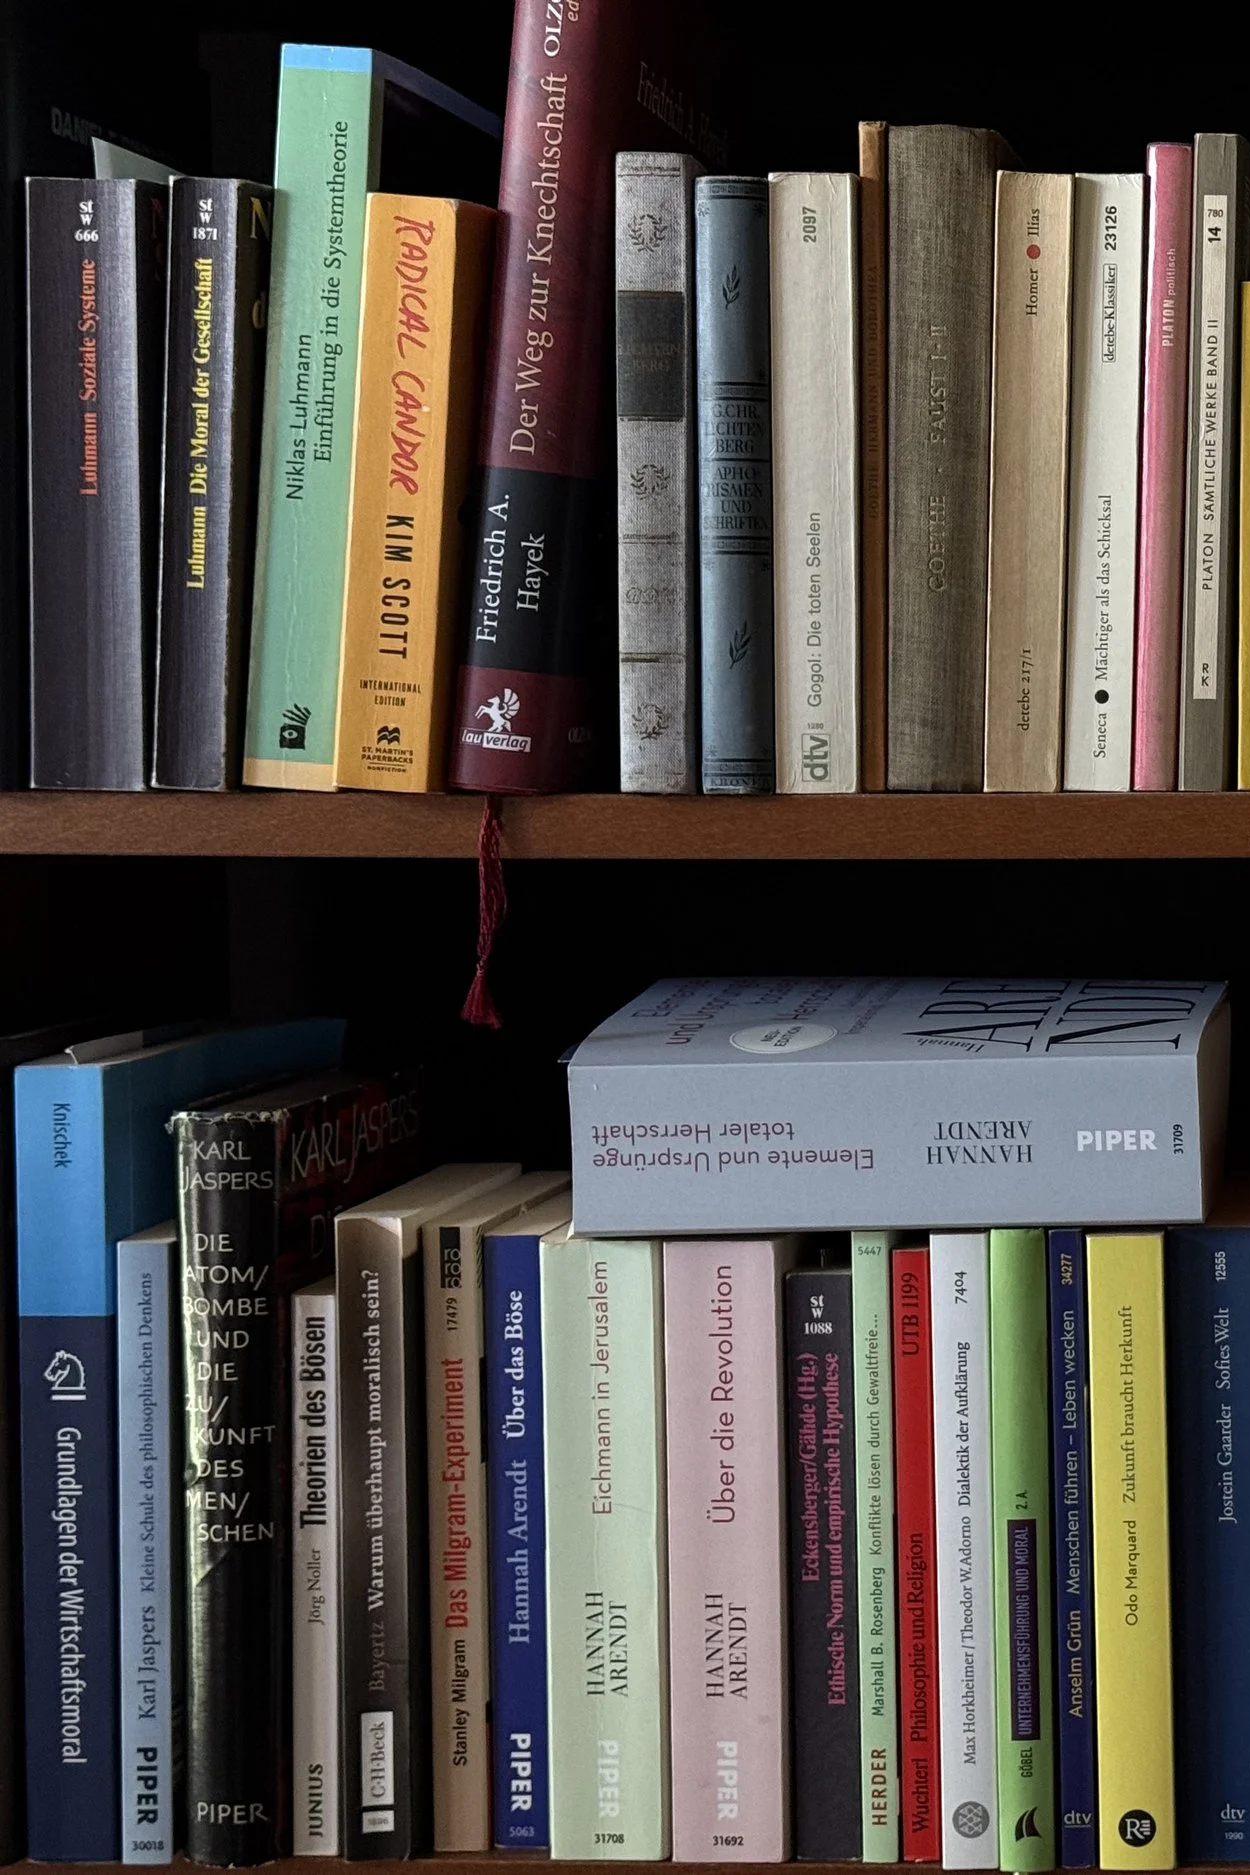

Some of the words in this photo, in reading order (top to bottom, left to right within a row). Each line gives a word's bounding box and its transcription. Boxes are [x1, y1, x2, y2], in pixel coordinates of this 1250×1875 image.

[324, 121, 348, 270] Systemtheorie
[527, 73, 568, 265] Knechtschaft
[75, 230, 98, 241] 666
[803, 206, 816, 243] 2097
[1026, 208, 1040, 237] Ilias
[1104, 205, 1117, 251] 23126
[79, 259, 100, 331] Systeme
[193, 257, 213, 364] Gesellschaft
[321, 277, 340, 309] die
[394, 215, 434, 360] RADICAL
[529, 272, 550, 321] zur
[1026, 268, 1039, 316] Homer
[1104, 264, 1116, 361] detebe-Klassiker
[325, 315, 338, 338] in
[1207, 319, 1217, 330] II
[79, 334, 98, 402] Soziale
[516, 330, 553, 392] Weg
[1207, 334, 1217, 375] BAND
[192, 368, 210, 399] der
[314, 340, 343, 463] Einführung
[1205, 379, 1218, 437] WERKE
[80, 412, 99, 496] Luhmann
[190, 402, 210, 459] Moral
[388, 371, 425, 496] CANDOR
[509, 398, 539, 455] Der
[189, 463, 207, 495] Die
[1203, 438, 1216, 521] SÄMTLICHE
[488, 493, 510, 521] A.
[187, 506, 207, 590] Luhmann
[384, 515, 414, 563] KIM
[806, 512, 821, 568] Seelen
[1201, 534, 1213, 591] PLATON
[475, 529, 506, 644] Friedrich
[516, 533, 549, 612] Hayek
[807, 575, 821, 614] toten
[380, 578, 410, 659] SCOTT
[806, 620, 821, 645] Die
[360, 680, 421, 694] INTERNATIONAL
[375, 695, 406, 707] EDITION
[806, 648, 827, 708] Gogol:
[53, 1103, 71, 1168] Knischek
[193, 1142, 250, 1159] KARL
[592, 1124, 710, 1144] Herrschaft
[720, 1122, 795, 1140] totaler
[927, 1144, 1032, 1164] HANNAH
[934, 1122, 1032, 1139] ARENDT
[1077, 1130, 1157, 1151] PIPER
[1173, 1124, 1183, 1154] 31709
[184, 1167, 273, 1192] JASPERS
[593, 1151, 709, 1171] Ursprünge
[718, 1150, 759, 1171] und
[768, 1148, 874, 1169] Elemente
[955, 1271, 967, 1304] 7404
[1061, 1254, 1073, 1284] 34277
[447, 1297, 457, 1331] 17479
[588, 1261, 609, 1374] Jerusalem
[709, 1265, 734, 1402] Revolution
[1119, 1305, 1131, 1375] Herkunft
[299, 1316, 325, 1381] Bösen
[299, 1390, 325, 1428] des
[592, 1381, 609, 1402] in
[1121, 1379, 1133, 1433] braucht
[710, 1412, 734, 1450] die
[51, 1427, 83, 1547] Grundlagen
[299, 1435, 326, 1528] Theorien
[442, 1358, 471, 1580] Milgram-Experiment
[590, 1408, 611, 1514] Eichmann
[1122, 1436, 1135, 1504] Zukunft
[707, 1460, 735, 1523] Über
[58, 1552, 84, 1586] der
[1124, 1519, 1140, 1589] Marquard
[445, 1589, 468, 1629] Das
[1124, 1594, 1137, 1625] Odo
[453, 1640, 469, 1702] Milgram
[586, 1591, 604, 1696] HANNAH
[609, 1601, 628, 1697] ARENDT
[60, 1589, 87, 1764] Wirtschaftsmoral
[453, 1704, 469, 1766] Stanley
[137, 1747, 157, 1824] PIPER
[308, 1764, 323, 1836] JUNIUS
[510, 1733, 532, 1812] PIPER
[872, 1748, 886, 1825] HERDER
[197, 1802, 268, 1824] PIPER
[595, 1834, 624, 1843] 31708
[133, 1841, 164, 1851] 30018
[713, 1836, 743, 1846] 31692
